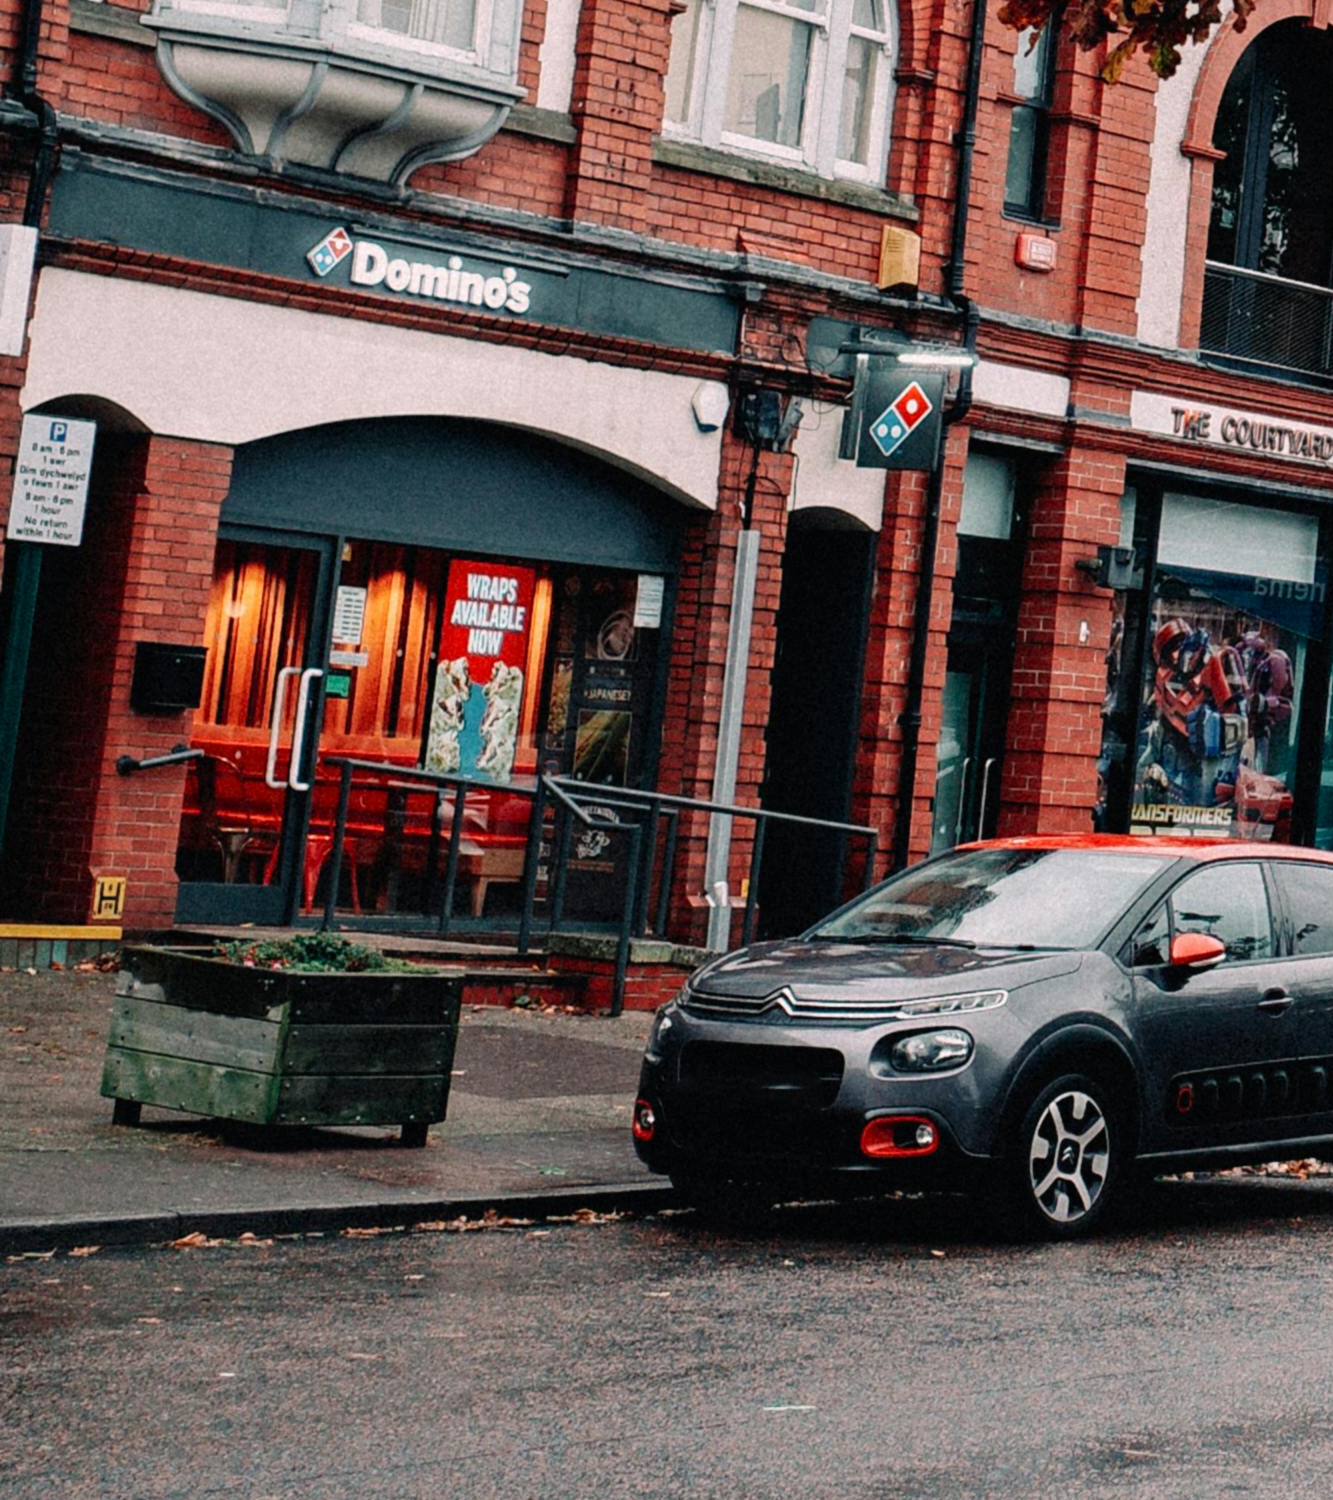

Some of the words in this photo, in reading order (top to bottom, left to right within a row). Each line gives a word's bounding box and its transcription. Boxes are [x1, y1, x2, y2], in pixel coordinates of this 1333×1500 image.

[351, 241, 532, 314] Domino's
[53, 424, 65, 440] P
[1171, 406, 1212, 440] THE
[467, 573, 518, 603] WRAPS
[451, 600, 525, 631] AVAILABLE
[467, 628, 503, 656] NOW
[98, 882, 121, 914] H
